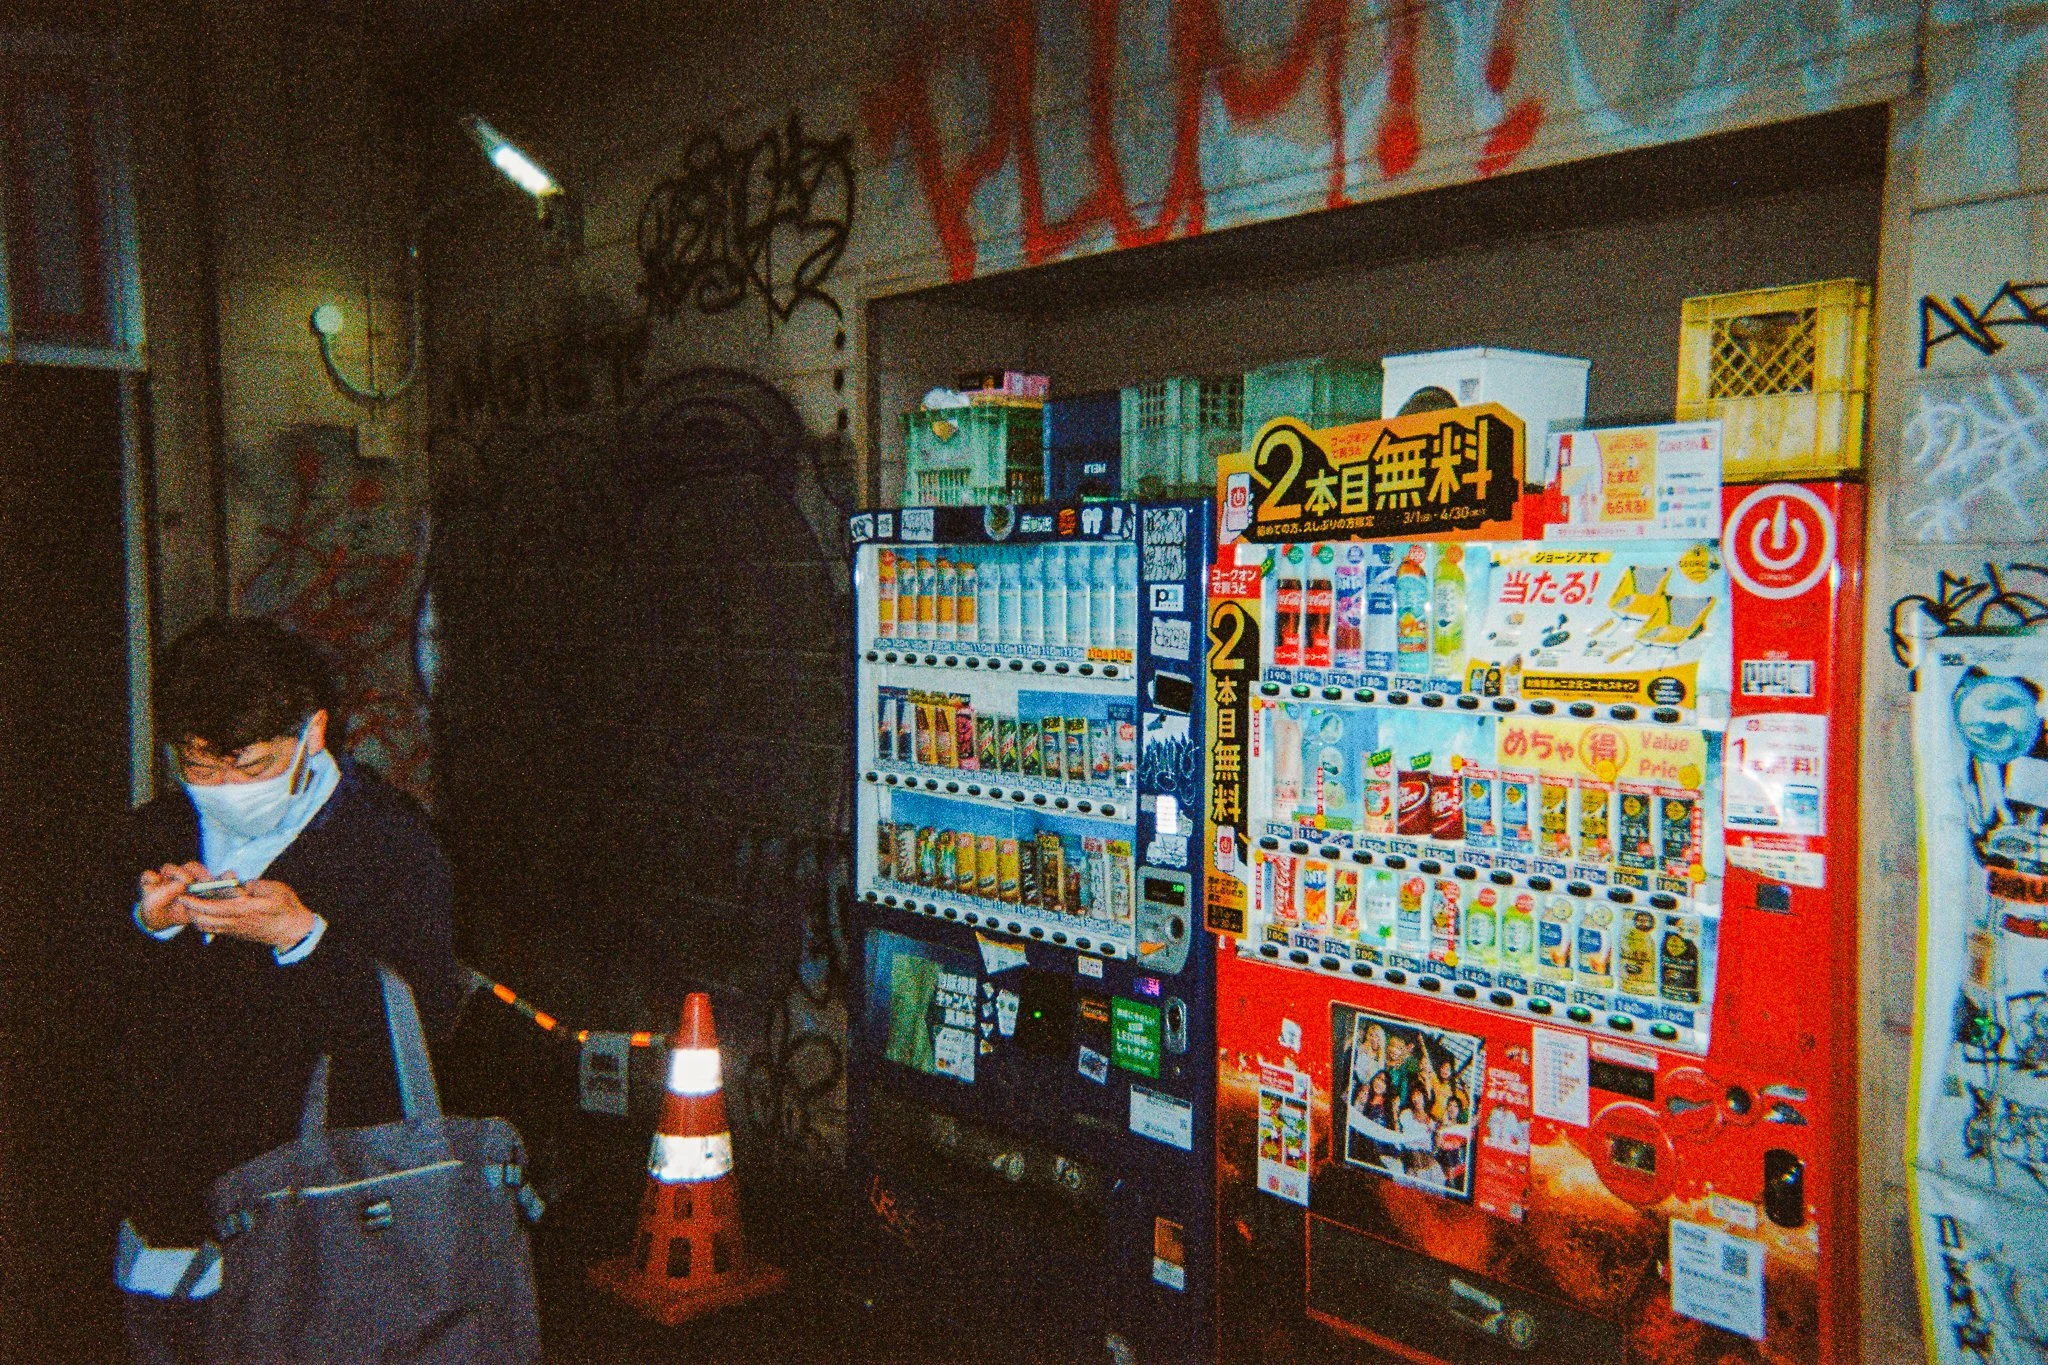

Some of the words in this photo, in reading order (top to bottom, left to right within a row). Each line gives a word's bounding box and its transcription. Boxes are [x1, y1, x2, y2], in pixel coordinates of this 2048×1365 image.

[1257, 419, 1492, 521] 2本目無料
[1212, 570, 1257, 583] コークオン
[1212, 582, 1247, 595] で買うと
[1500, 570, 1600, 605] 当たる!
[1212, 605, 1244, 823] 2本目無料
[1641, 731, 1690, 752] Value
[1639, 758, 1682, 779] Pric
